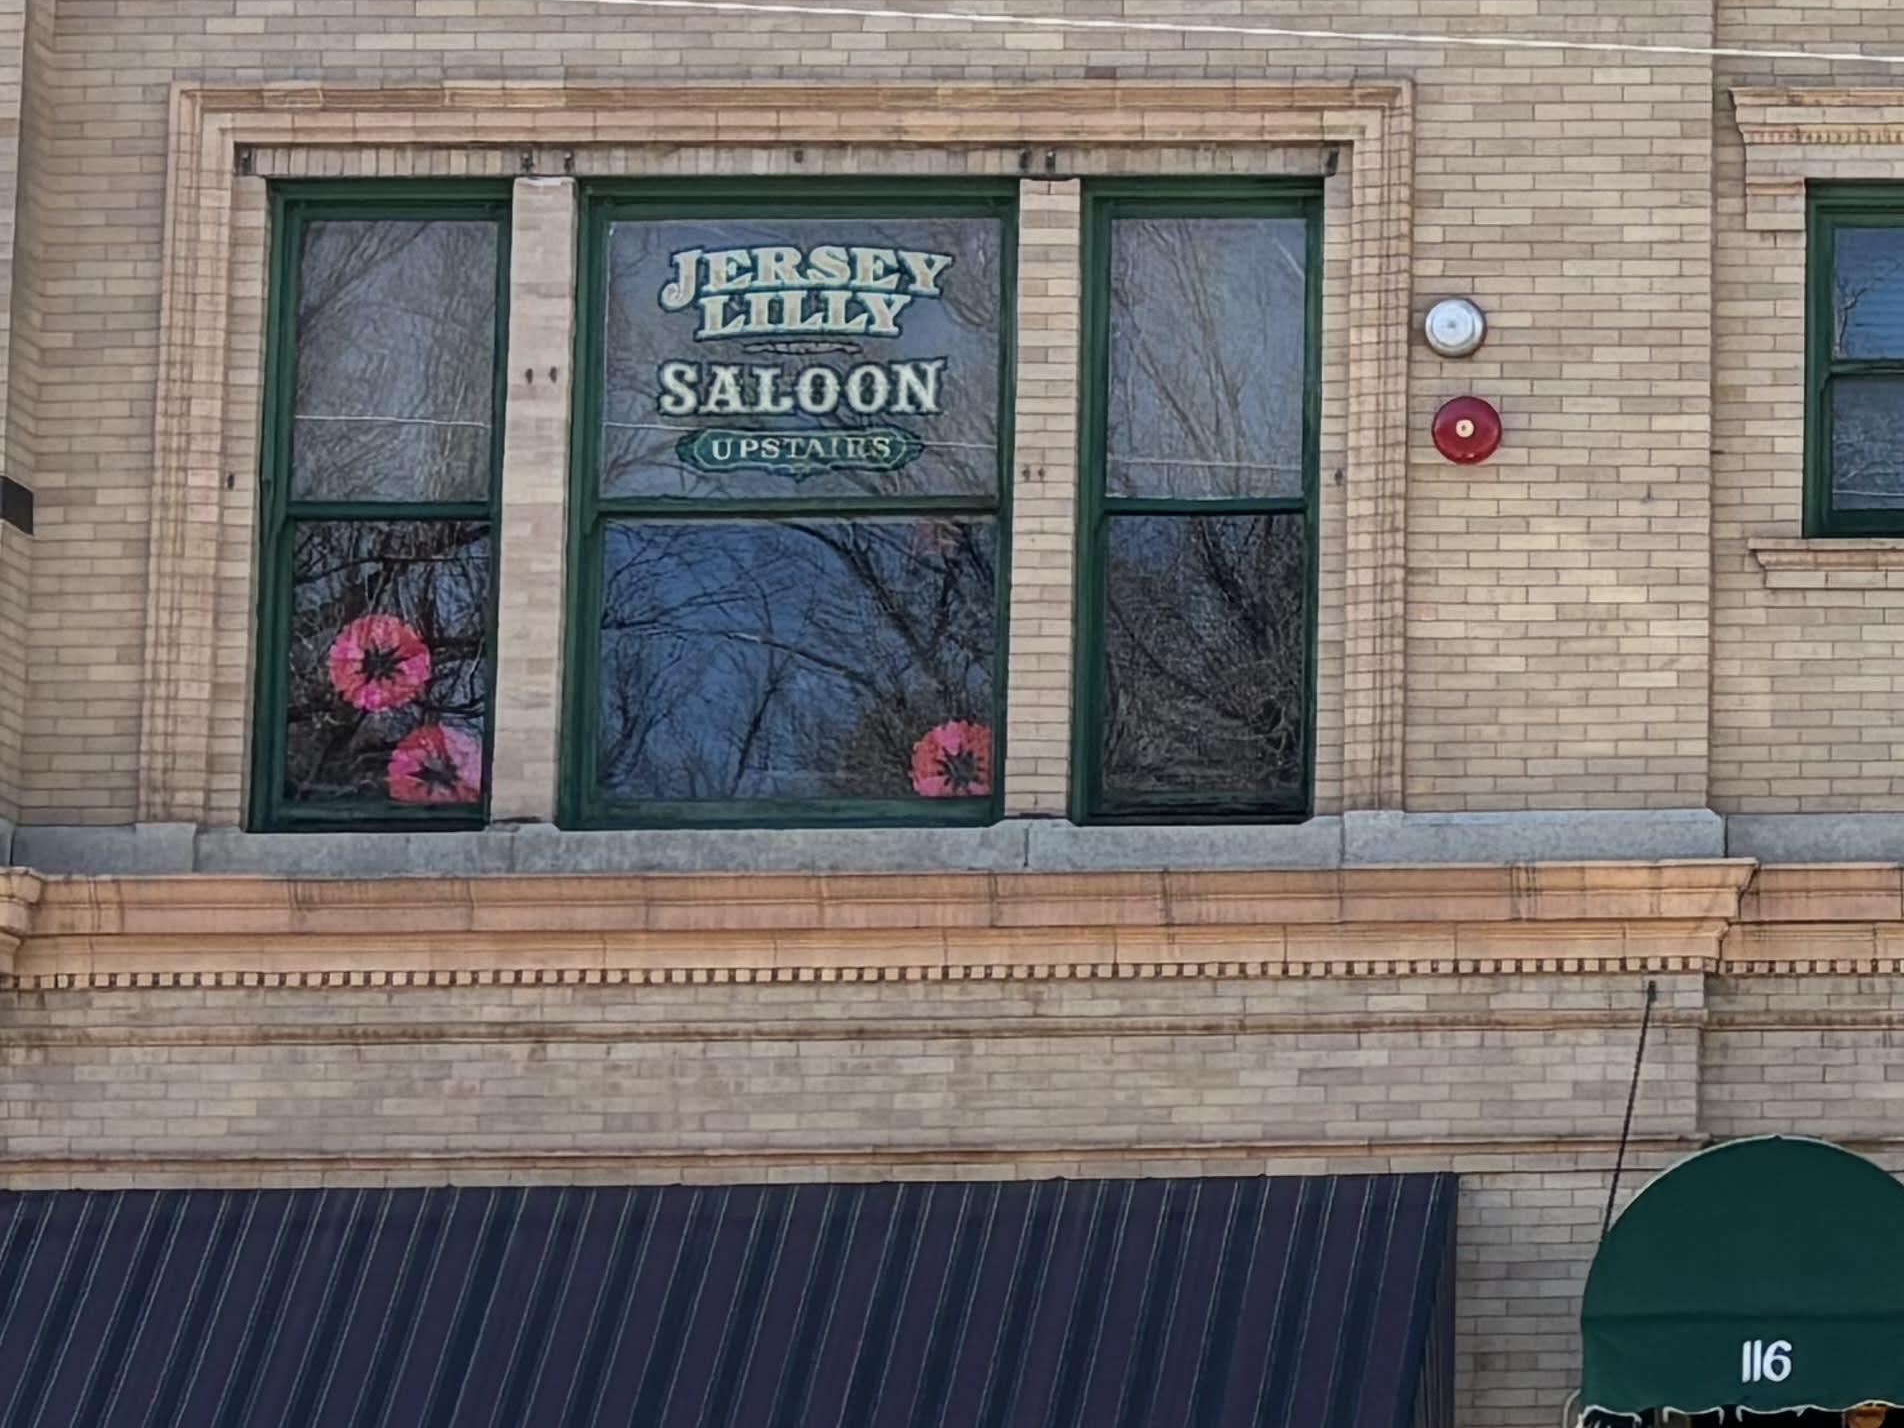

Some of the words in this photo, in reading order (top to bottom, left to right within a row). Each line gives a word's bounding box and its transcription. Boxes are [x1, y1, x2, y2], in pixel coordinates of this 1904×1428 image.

[658, 245, 954, 312] JERSEY
[695, 289, 913, 341] LILLY
[657, 356, 948, 417] SALOON
[711, 436, 892, 461] UPSTAIRS
[1741, 1339, 1793, 1383] 116
